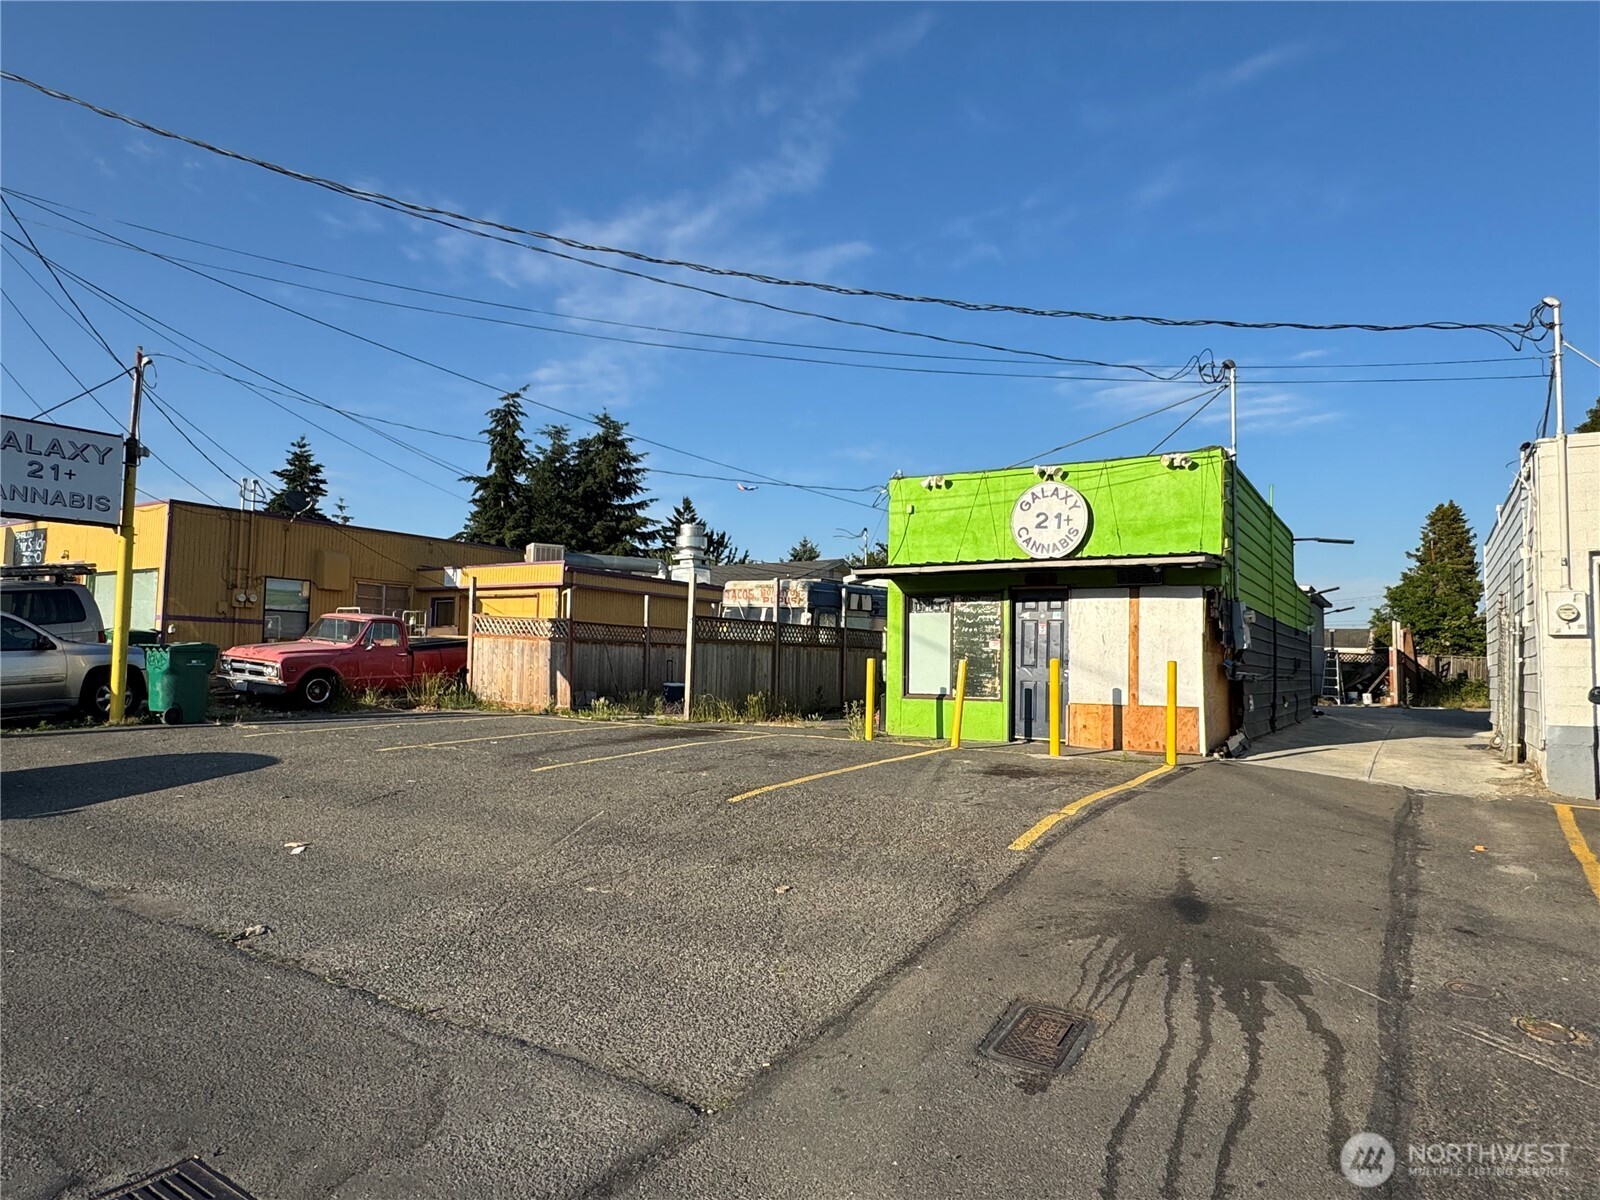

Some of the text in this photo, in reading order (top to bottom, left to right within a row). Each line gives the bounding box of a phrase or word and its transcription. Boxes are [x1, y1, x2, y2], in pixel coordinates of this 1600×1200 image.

[0, 430, 113, 465] ALAXY
[27, 460, 77, 481] 21+
[1020, 487, 1081, 511] GALAXY
[1035, 512, 1073, 529] 21+
[1018, 527, 1079, 554] CANNABIS
[724, 588, 755, 601] TACOS
